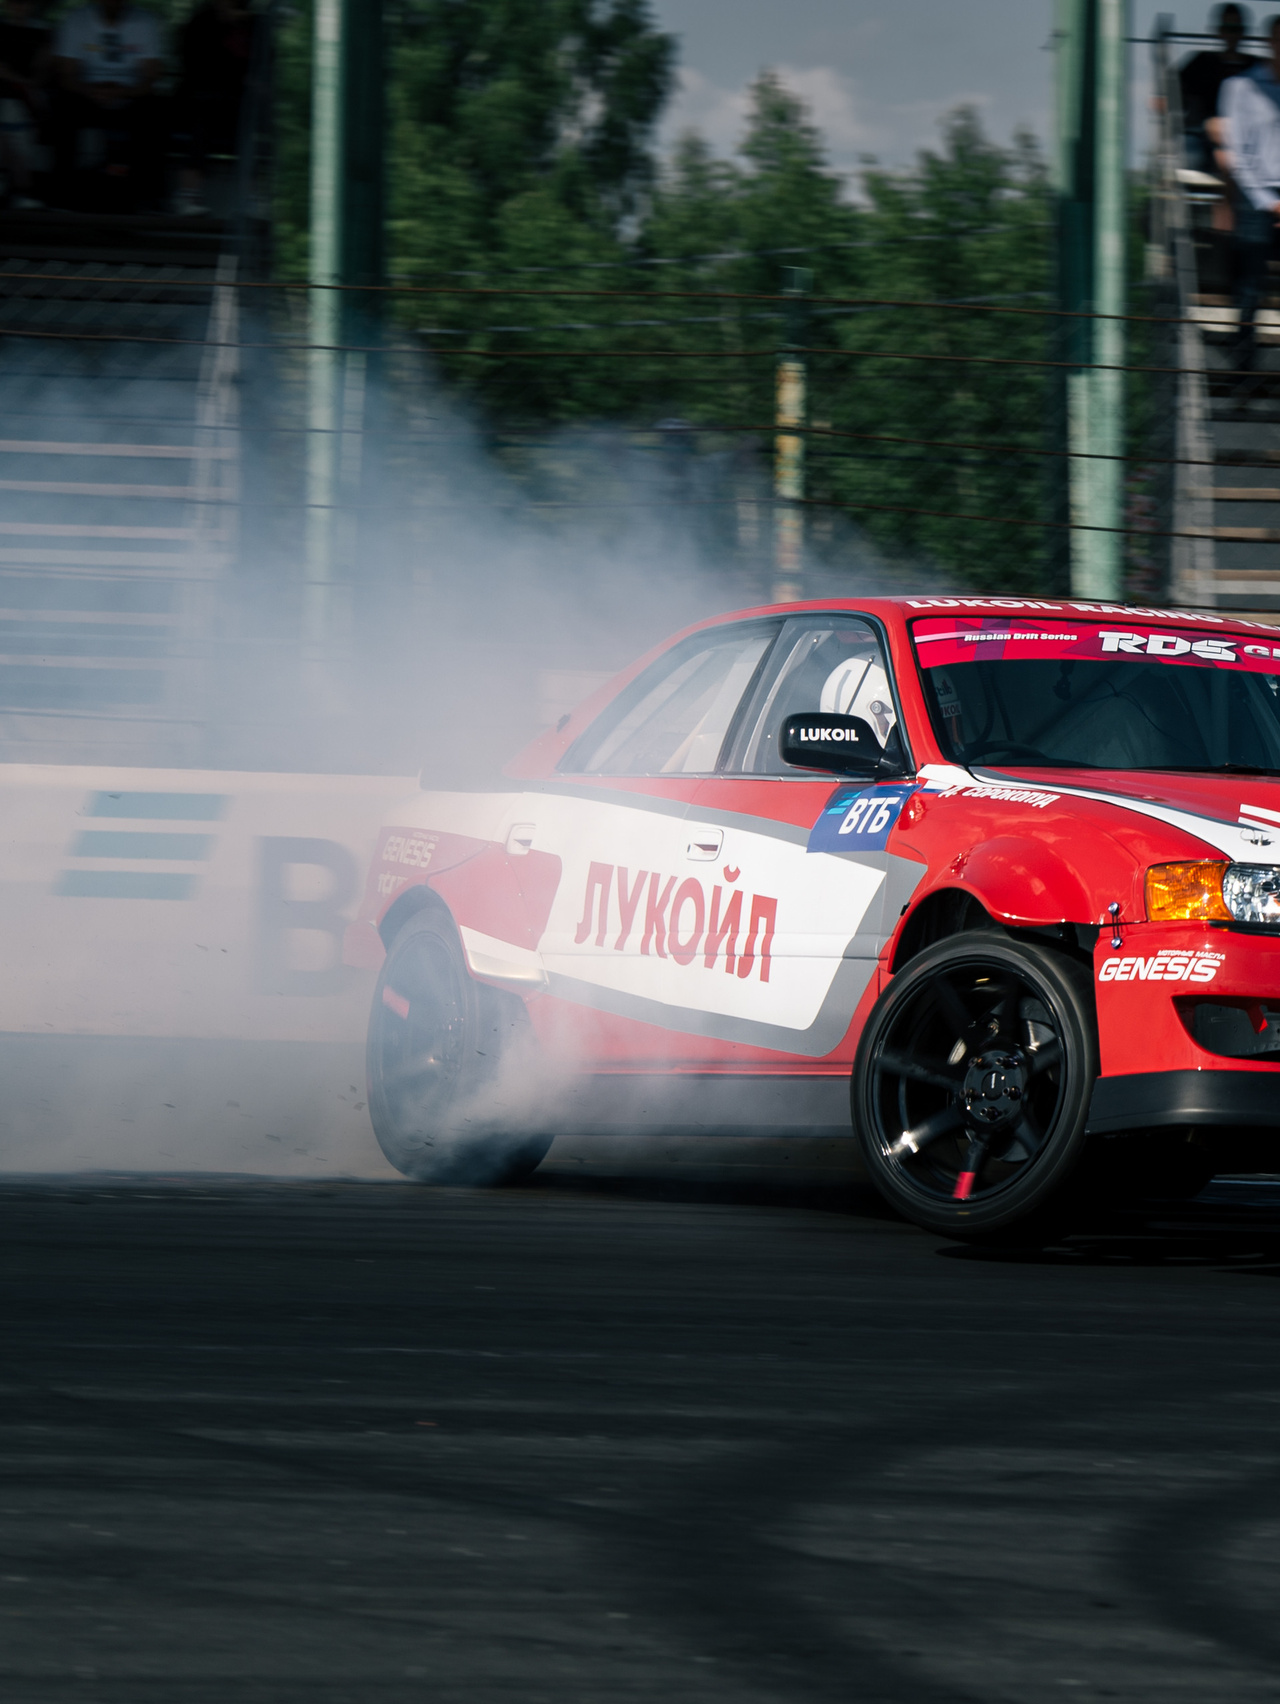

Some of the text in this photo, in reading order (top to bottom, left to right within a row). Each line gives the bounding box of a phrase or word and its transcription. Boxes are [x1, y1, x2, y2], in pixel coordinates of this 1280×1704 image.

[905, 599, 1064, 611] LUKOIL
[1069, 602, 1225, 624] RACING
[964, 632, 1078, 642] Russian Drift Series
[1098, 630, 1238, 663] RDS
[800, 727, 859, 742] LUKOIL
[838, 796, 900, 835] ВТБ
[381, 834, 436, 869] GENESIS
[573, 860, 779, 984] ЛУКОЙЛ
[1098, 956, 1221, 983] GENESIS
